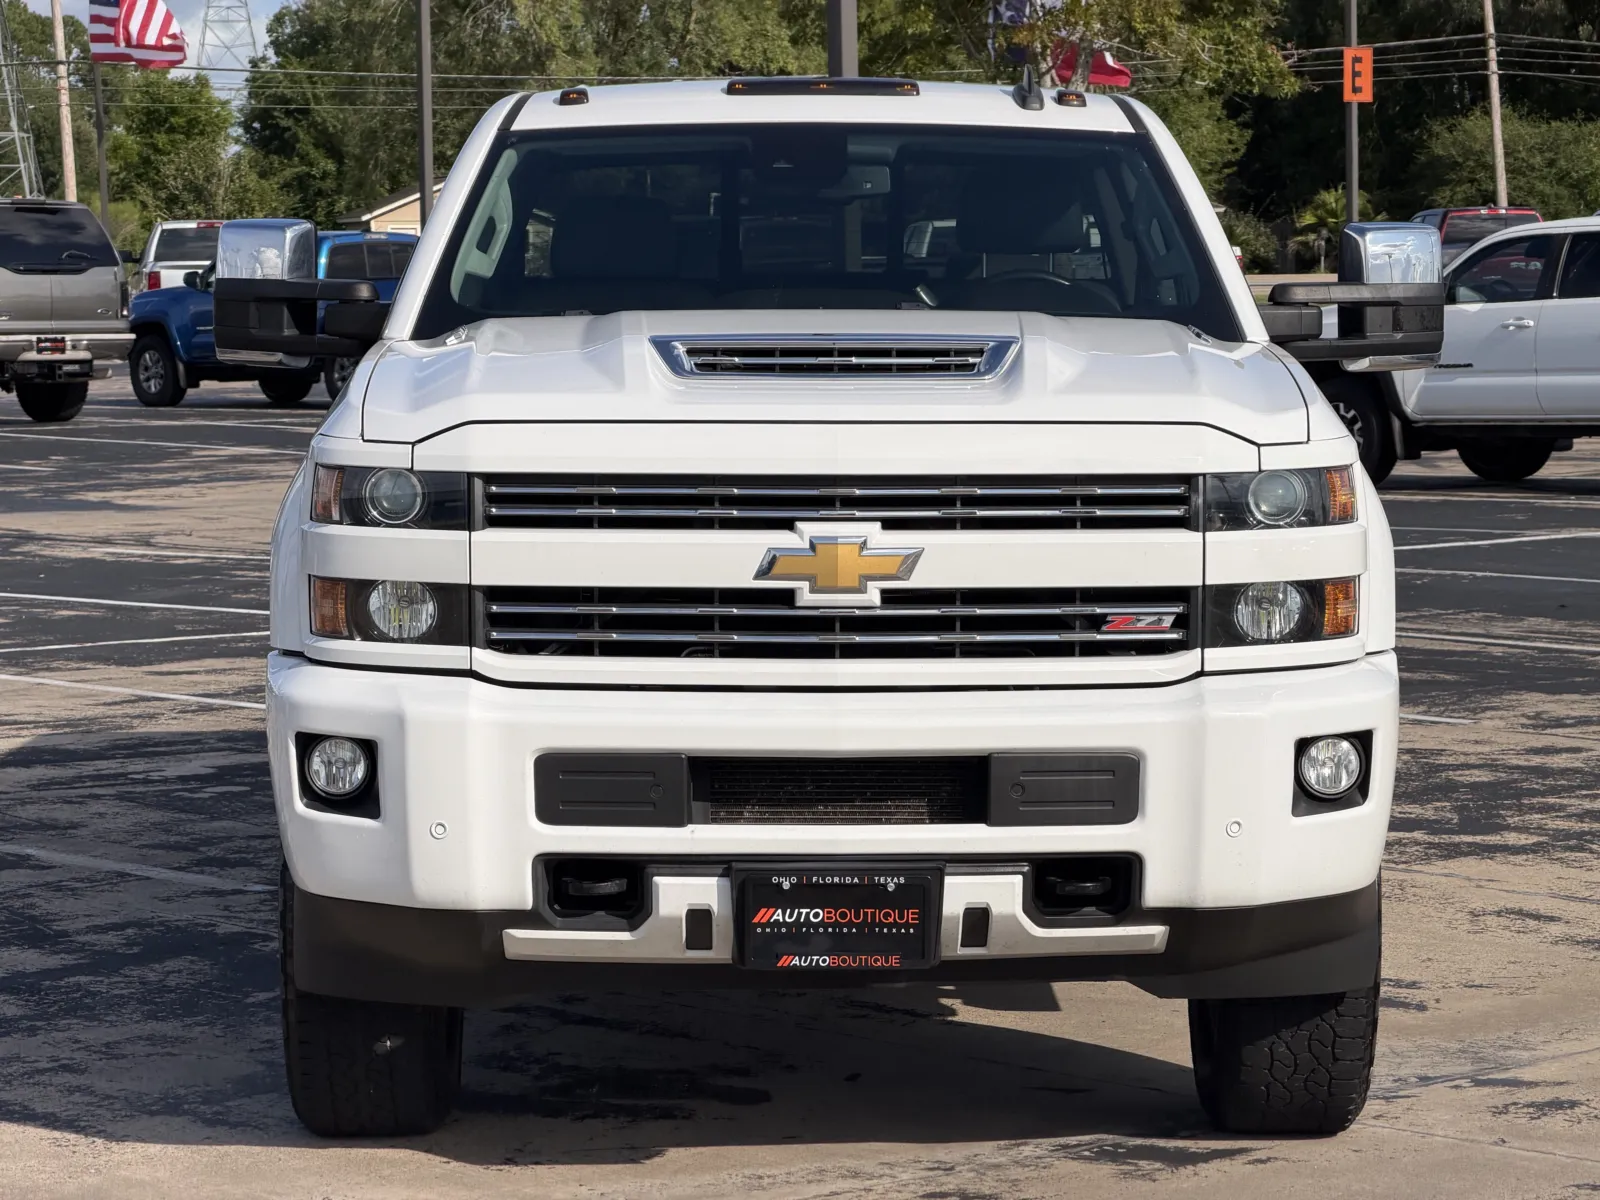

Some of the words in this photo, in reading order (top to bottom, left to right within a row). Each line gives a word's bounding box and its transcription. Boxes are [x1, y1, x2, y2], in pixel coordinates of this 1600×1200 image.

[1351, 56, 1363, 94] E
[1101, 613, 1177, 631] Z71
[772, 876, 797, 884] OHIO
[812, 876, 860, 884] FLORIDA
[874, 876, 905, 884] TEXAS
[770, 908, 919, 923] AUTOBOUTIQUE
[789, 955, 901, 967] AUTOBOUTIQUE
